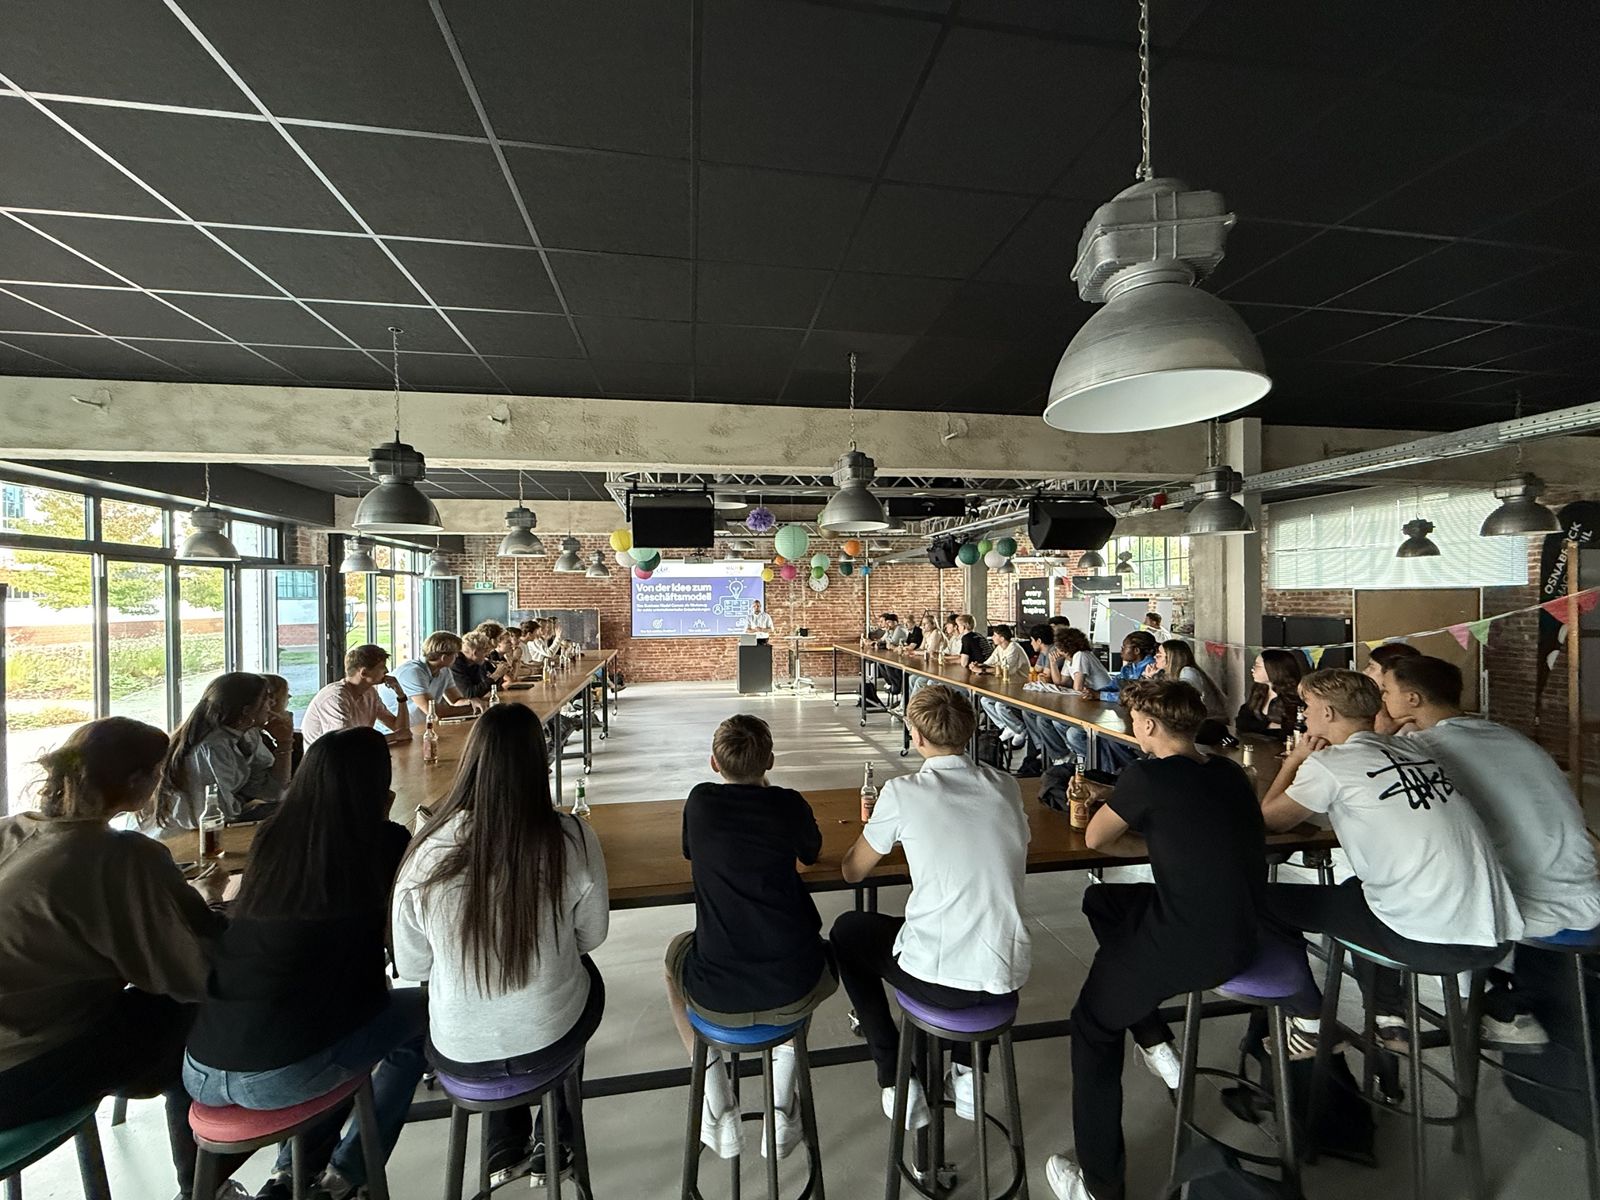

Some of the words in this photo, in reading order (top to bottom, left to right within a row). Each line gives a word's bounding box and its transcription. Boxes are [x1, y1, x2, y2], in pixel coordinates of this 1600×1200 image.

[636, 583, 654, 592] Von
[655, 583, 671, 592] der
[672, 583, 692, 592] Idee
[692, 584, 712, 592] zum
[636, 592, 712, 602] Geschäftsmodell
